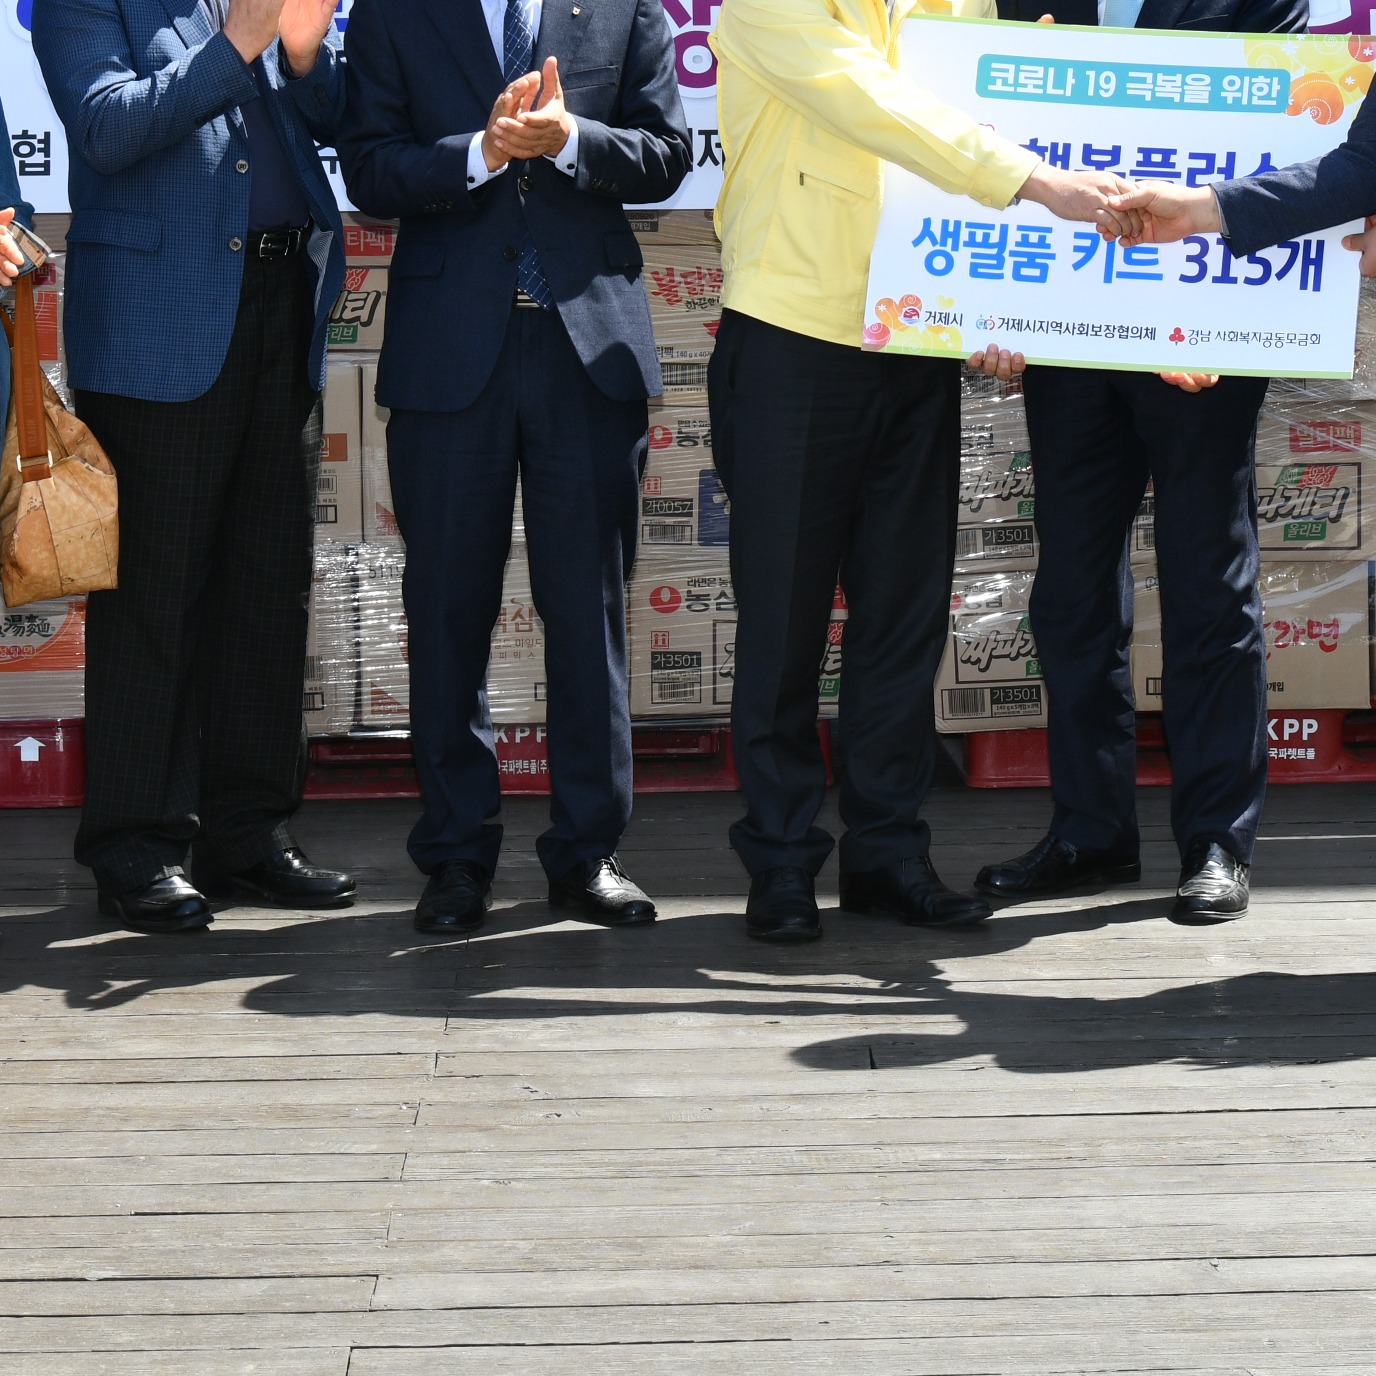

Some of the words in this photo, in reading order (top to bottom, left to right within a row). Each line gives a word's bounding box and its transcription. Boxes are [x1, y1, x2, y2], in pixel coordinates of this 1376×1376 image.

[987, 63, 1076, 97] 코로나
[1085, 70, 1117, 98] 19
[1126, 70, 1211, 104] 극복을
[1220, 73, 1281, 106] 위한
[911, 215, 1057, 283] 생필품
[1071, 230, 1164, 283] 키트
[1178, 234, 1324, 292] 315개
[924, 310, 964, 327] 거제시
[328, 326, 354, 341] 리브
[997, 316, 1157, 341] 거제시지역사회보장협의체
[1188, 328, 1212, 346] 경남
[1215, 330, 1322, 349] 사회복지공동모금회
[1296, 425, 1355, 448] 멀티팩
[645, 500, 691, 514] 가0057
[985, 528, 1031, 544] 가3501
[1286, 523, 1323, 538] 올리브
[686, 577, 716, 588] 라면은
[1264, 613, 1339, 656] 라면
[653, 654, 699, 668] 가3501
[992, 687, 1038, 703] 가3501
[1267, 718, 1319, 741] KPP
[1268, 748, 1316, 760] 국파렛트풀
